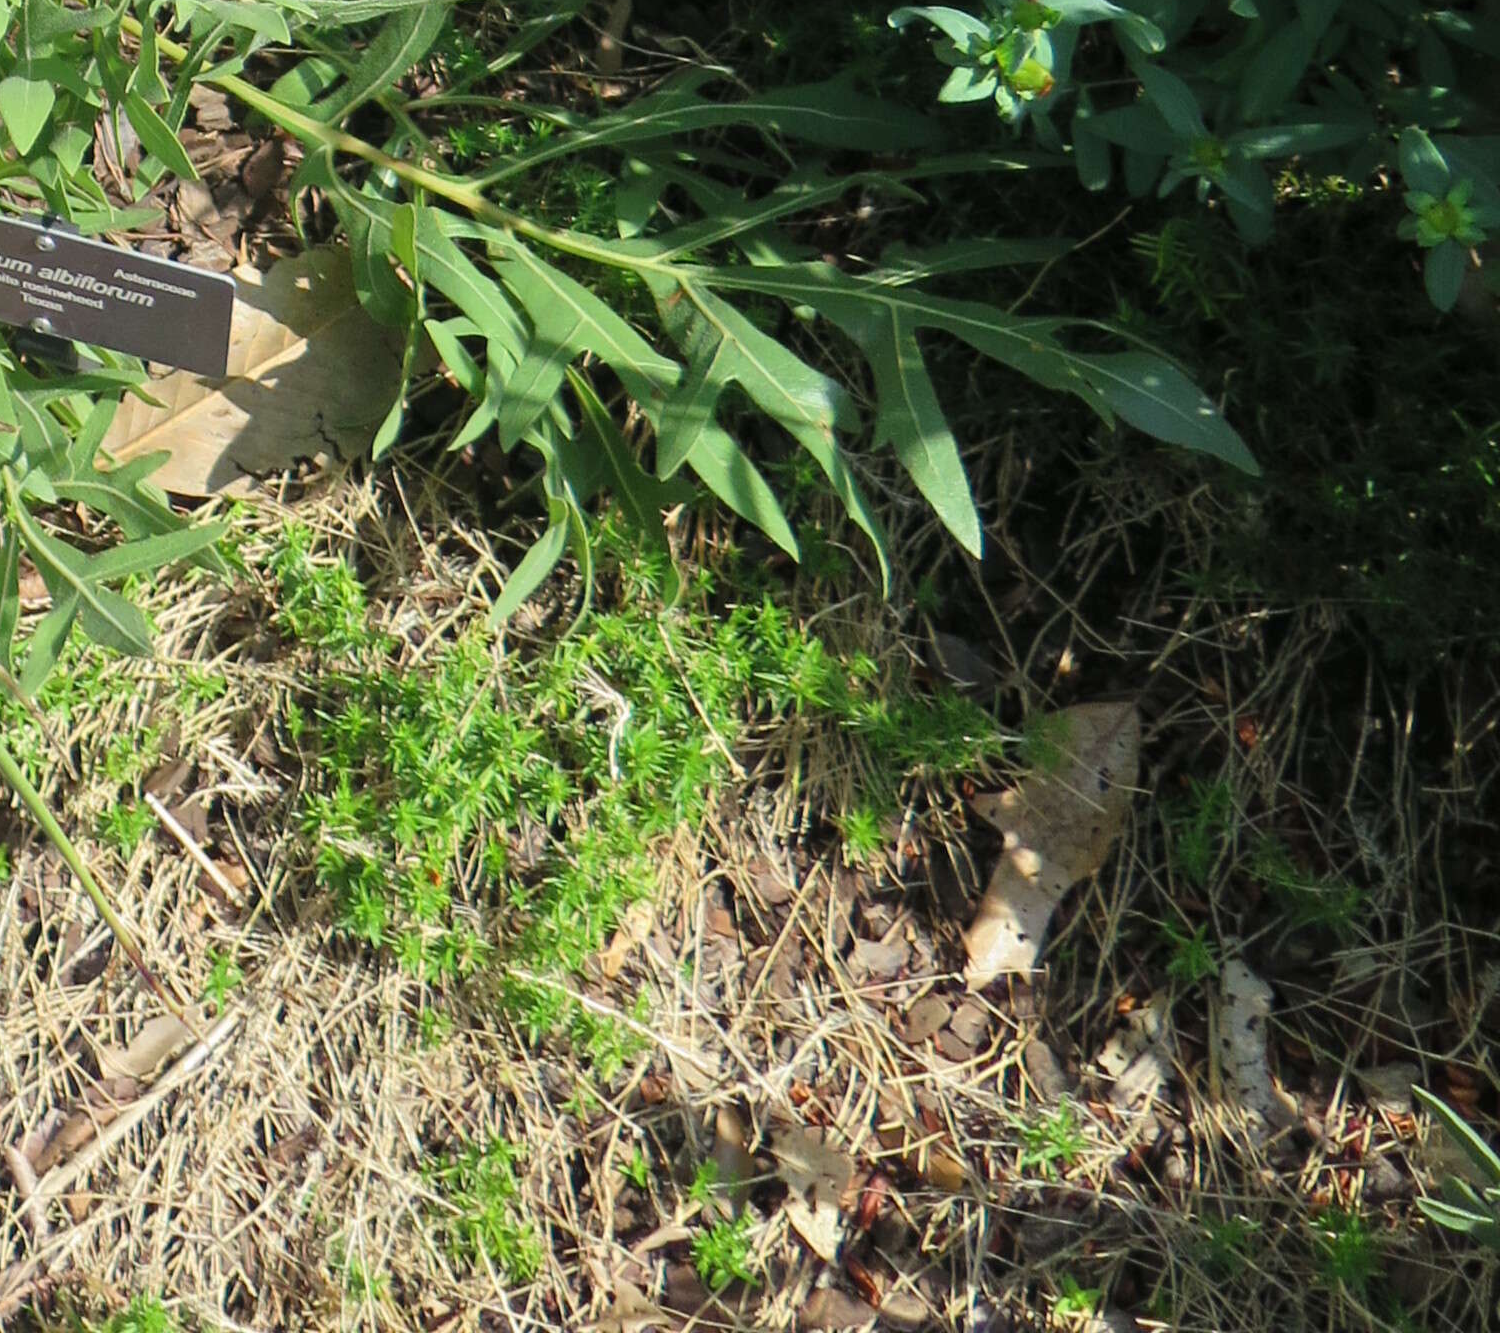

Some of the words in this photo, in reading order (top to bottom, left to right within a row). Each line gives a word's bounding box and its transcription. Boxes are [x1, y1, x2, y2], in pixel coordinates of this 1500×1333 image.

[36, 264, 155, 308] albiflorum
[114, 268, 196, 299] Asteraceae
[20, 291, 64, 313] Texas
